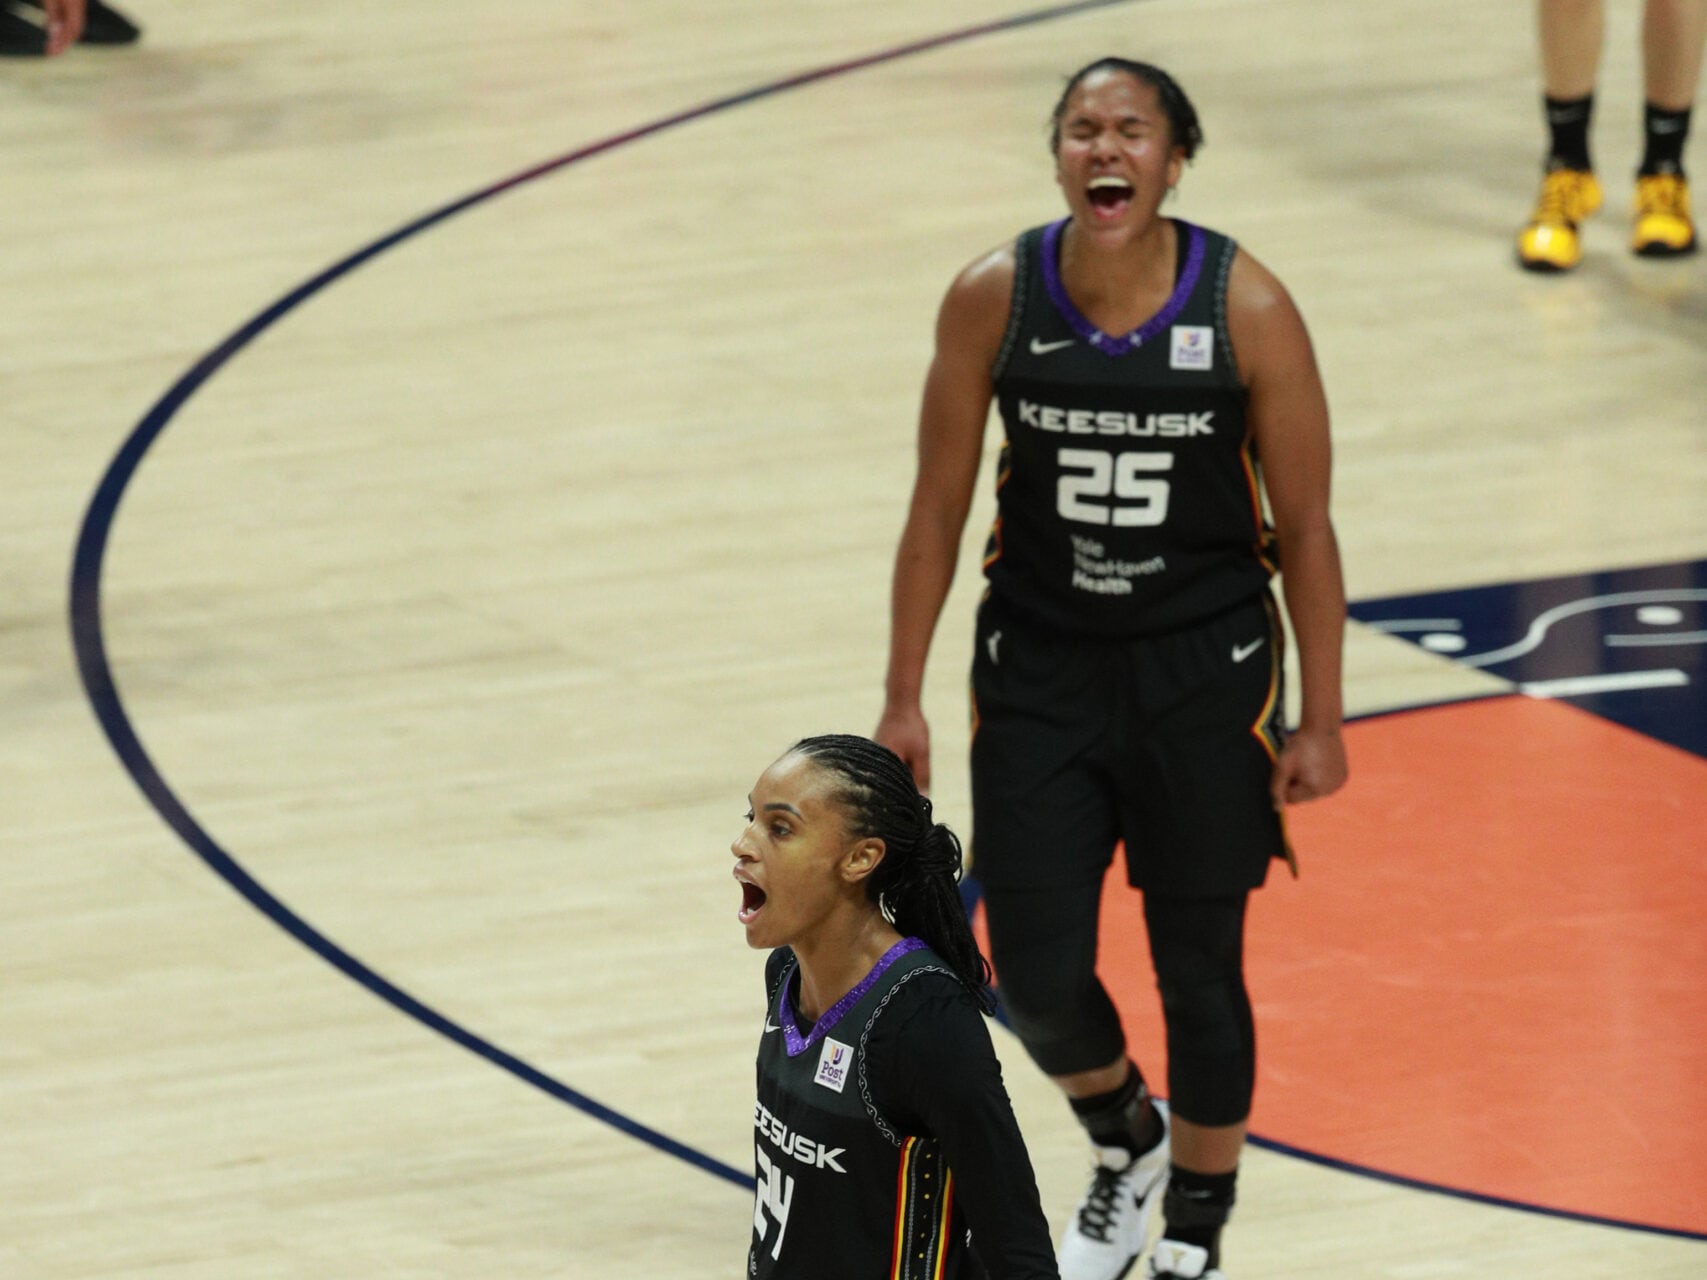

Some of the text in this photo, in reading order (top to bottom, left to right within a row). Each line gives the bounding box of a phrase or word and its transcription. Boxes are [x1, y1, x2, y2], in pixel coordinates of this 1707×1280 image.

[1018, 399, 1215, 437] KEESUSK
[1057, 448, 1174, 527] 25
[1072, 570, 1132, 595] Health
[821, 1060, 843, 1081] Post
[754, 1100, 847, 1174] EESUSK
[754, 1143, 795, 1261] 24
